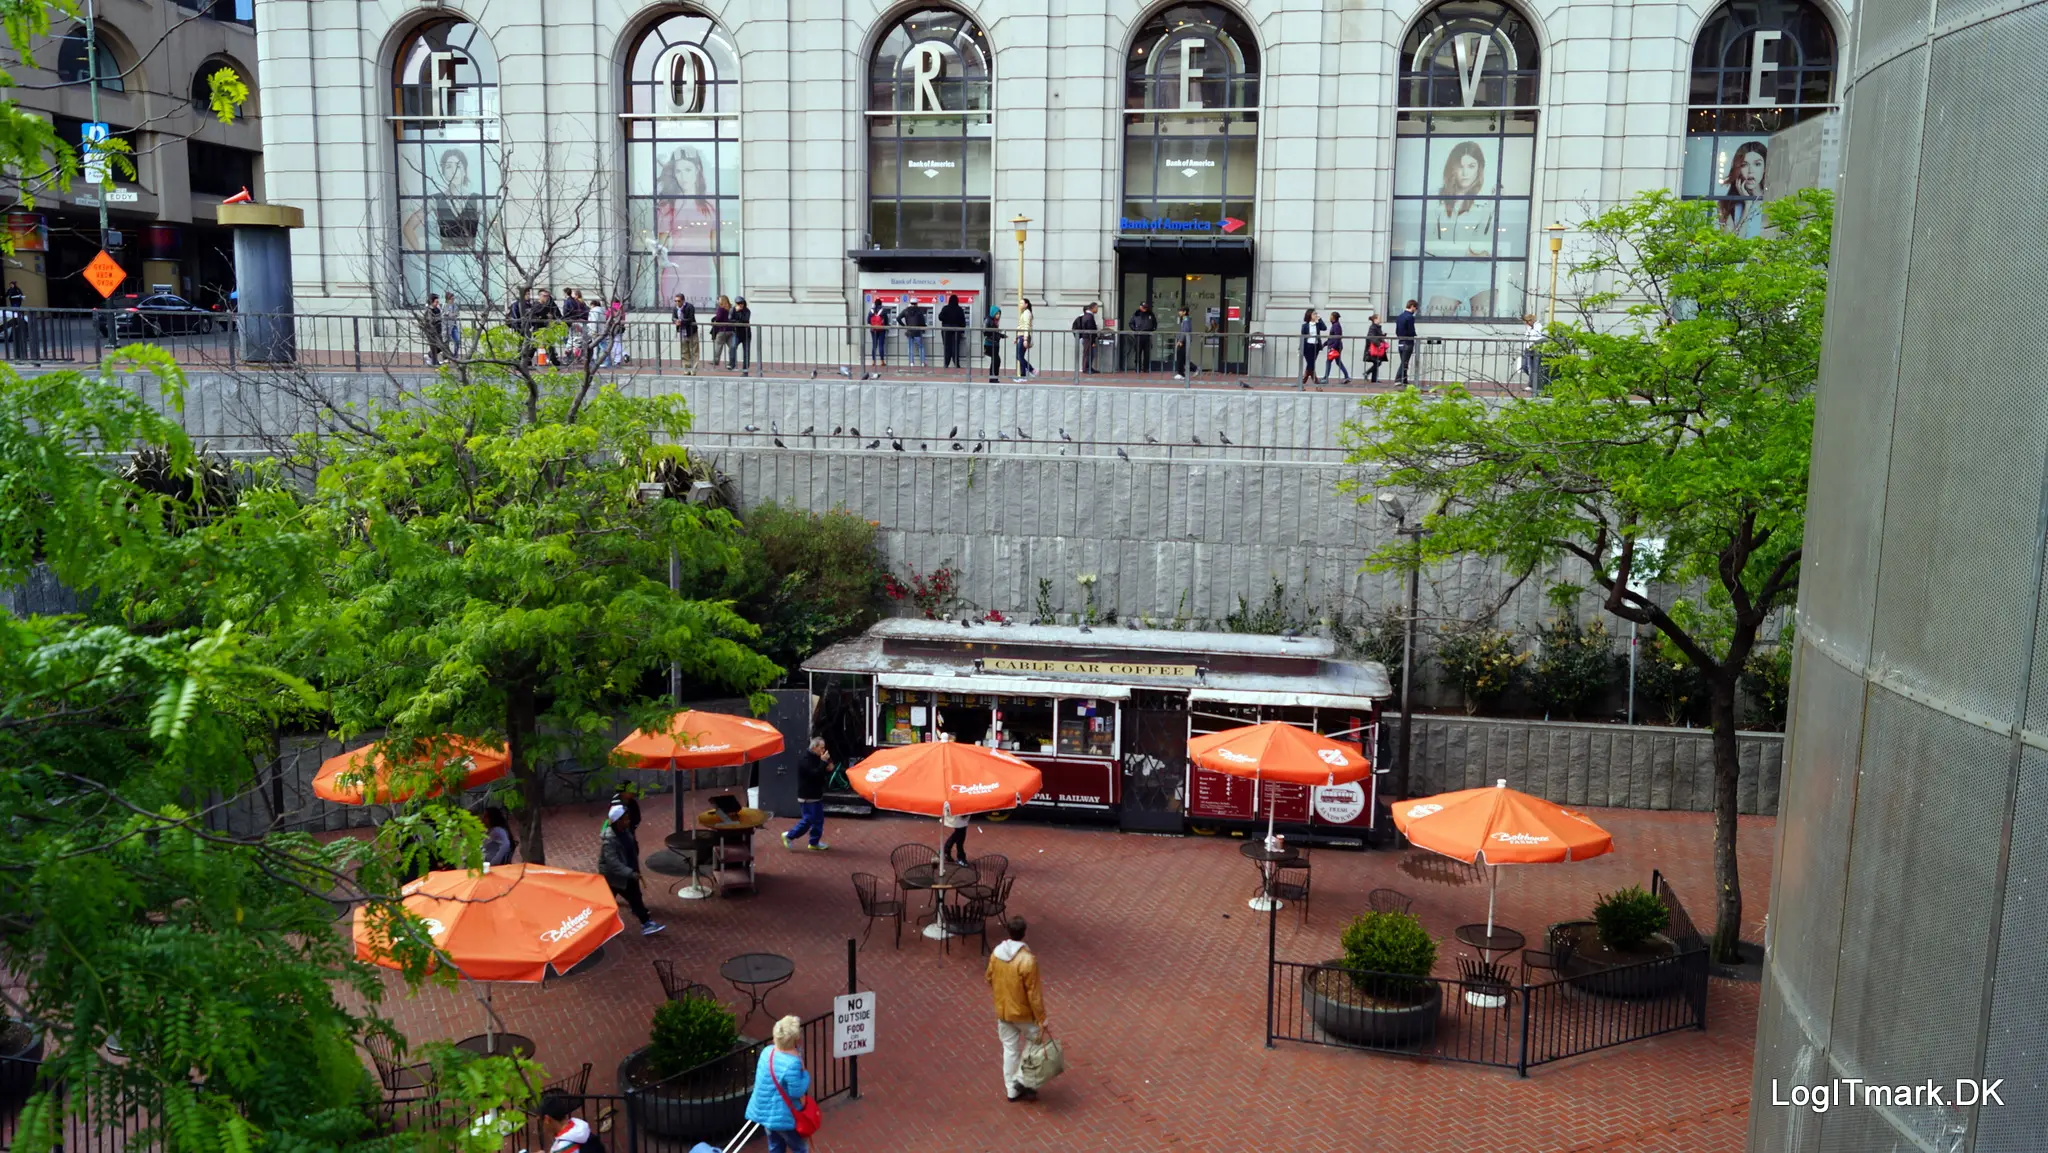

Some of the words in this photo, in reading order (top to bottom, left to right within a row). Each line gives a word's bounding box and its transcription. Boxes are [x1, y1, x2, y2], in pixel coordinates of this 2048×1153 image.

[908, 160, 923, 168] Bank
[930, 160, 955, 168] America
[1166, 159, 1181, 167] Bank
[1189, 159, 1215, 167] America
[1120, 216, 1149, 230] Bank
[1150, 217, 1162, 230] of
[1163, 217, 1212, 231] America
[995, 660, 1054, 671] CABLE
[1064, 663, 1100, 673] CAR
[1110, 665, 1184, 676] COFFEE
[1059, 793, 1100, 803] RAILWAY
[847, 998, 863, 1012] NO
[838, 1010, 871, 1024] OUTSIDE
[846, 1023, 865, 1034] FOOD
[842, 1039, 867, 1051] DRINK
